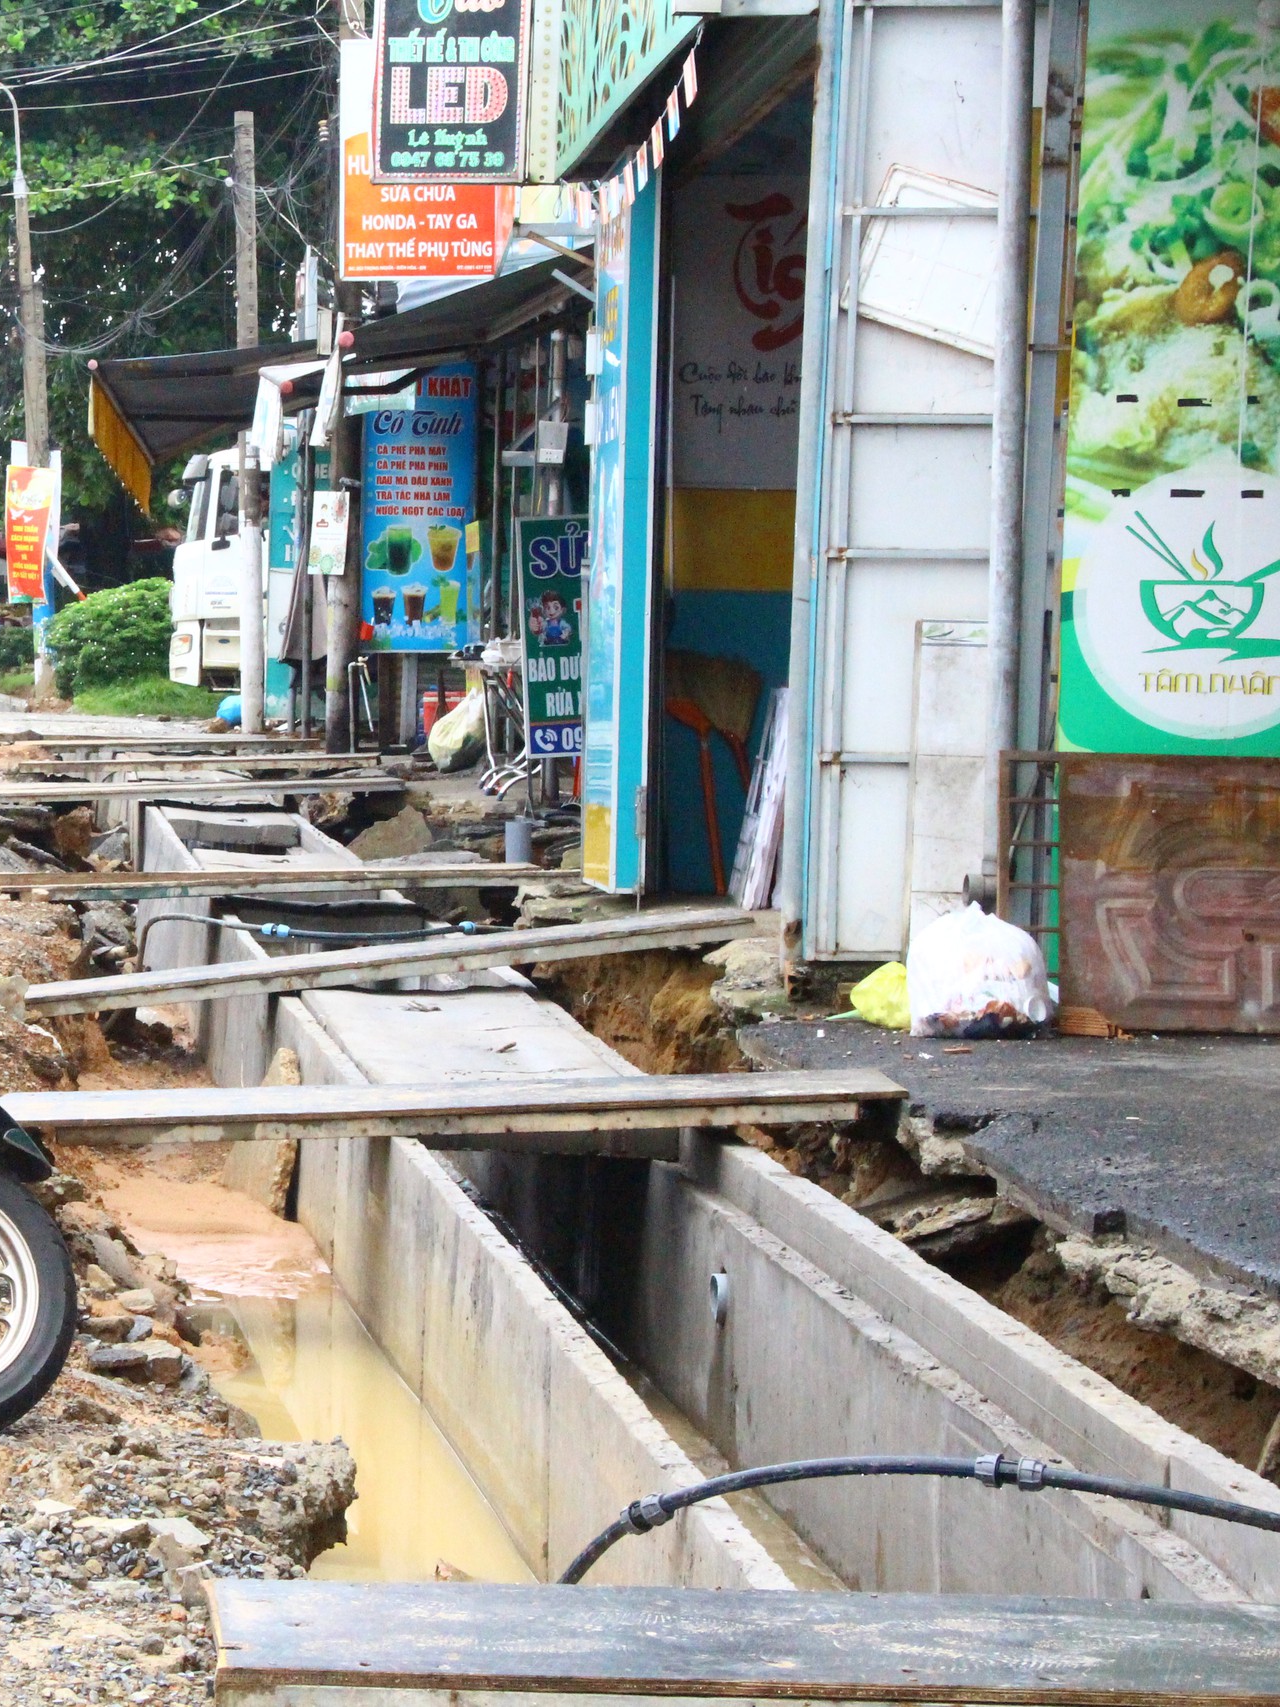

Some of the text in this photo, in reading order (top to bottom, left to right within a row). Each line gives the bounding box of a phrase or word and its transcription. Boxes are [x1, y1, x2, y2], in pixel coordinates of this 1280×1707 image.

[390, 66, 508, 124] LED
[348, 154, 369, 175] HU
[362, 213, 478, 231] HONDA TAY GA
[347, 237, 493, 261] THAY THẾ PHỤ TÙNG
[428, 375, 471, 397] KHÁT
[373, 409, 405, 435] Cô
[377, 443, 388, 455] CÀ
[391, 444, 406, 455] PHÊ
[409, 446, 426, 455] PHA
[376, 459, 448, 471] CÀ PHÊ PHA PHIN
[376, 476, 393, 485] RAU
[431, 477, 453, 486] XANH
[529, 521, 589, 579] SỬ
[528, 651, 555, 683] BẢO
[1138, 668, 1203, 693] TÂM
[546, 686, 574, 717] RỬA
[561, 726, 582, 750] 09
